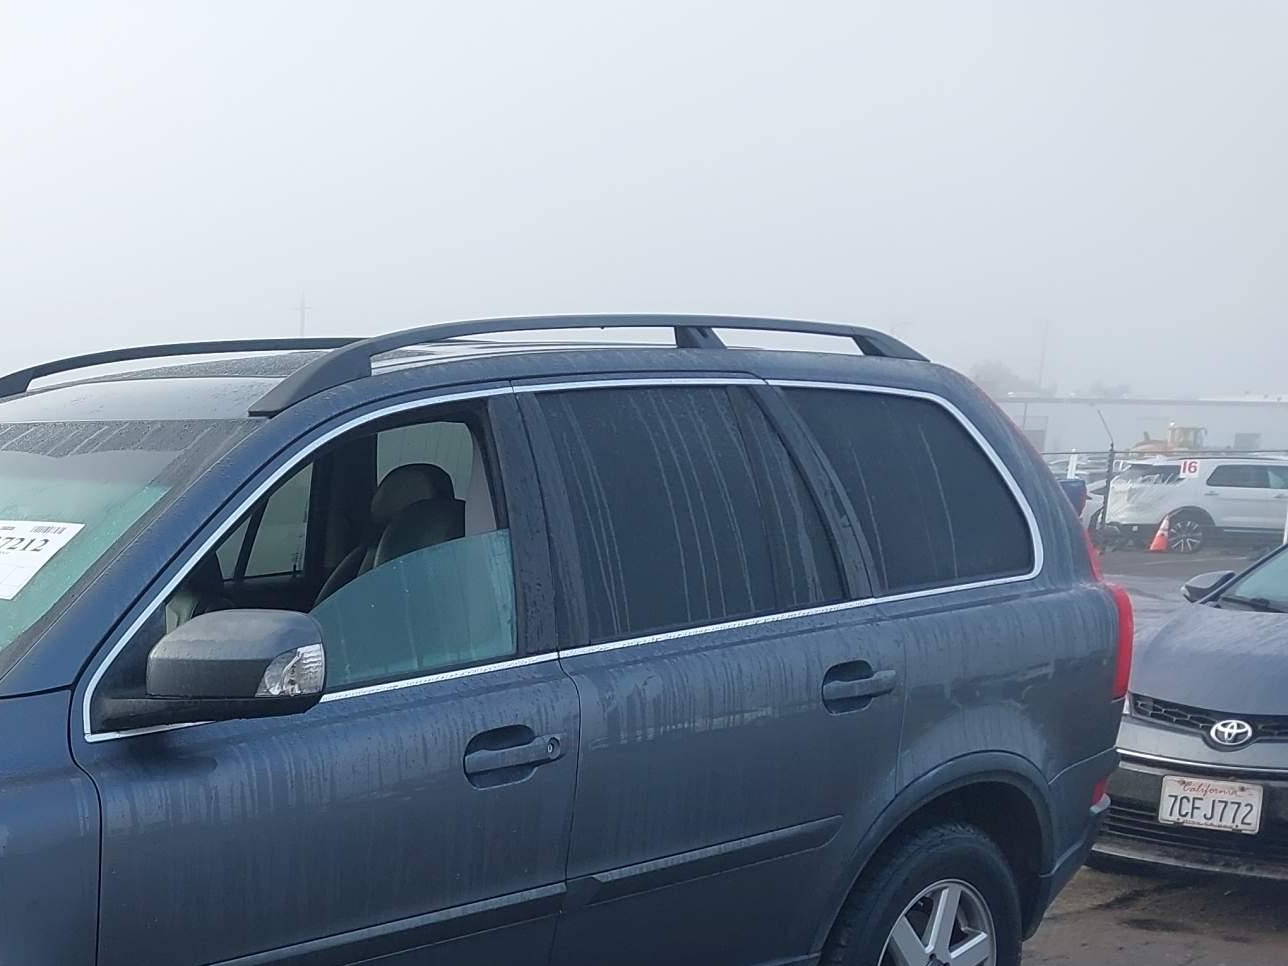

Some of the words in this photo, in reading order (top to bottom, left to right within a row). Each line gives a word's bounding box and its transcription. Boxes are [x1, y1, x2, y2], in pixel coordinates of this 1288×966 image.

[1182, 460, 1198, 473] 16
[1182, 780, 1239, 797] California
[1167, 794, 1254, 826] 7CFJ772
